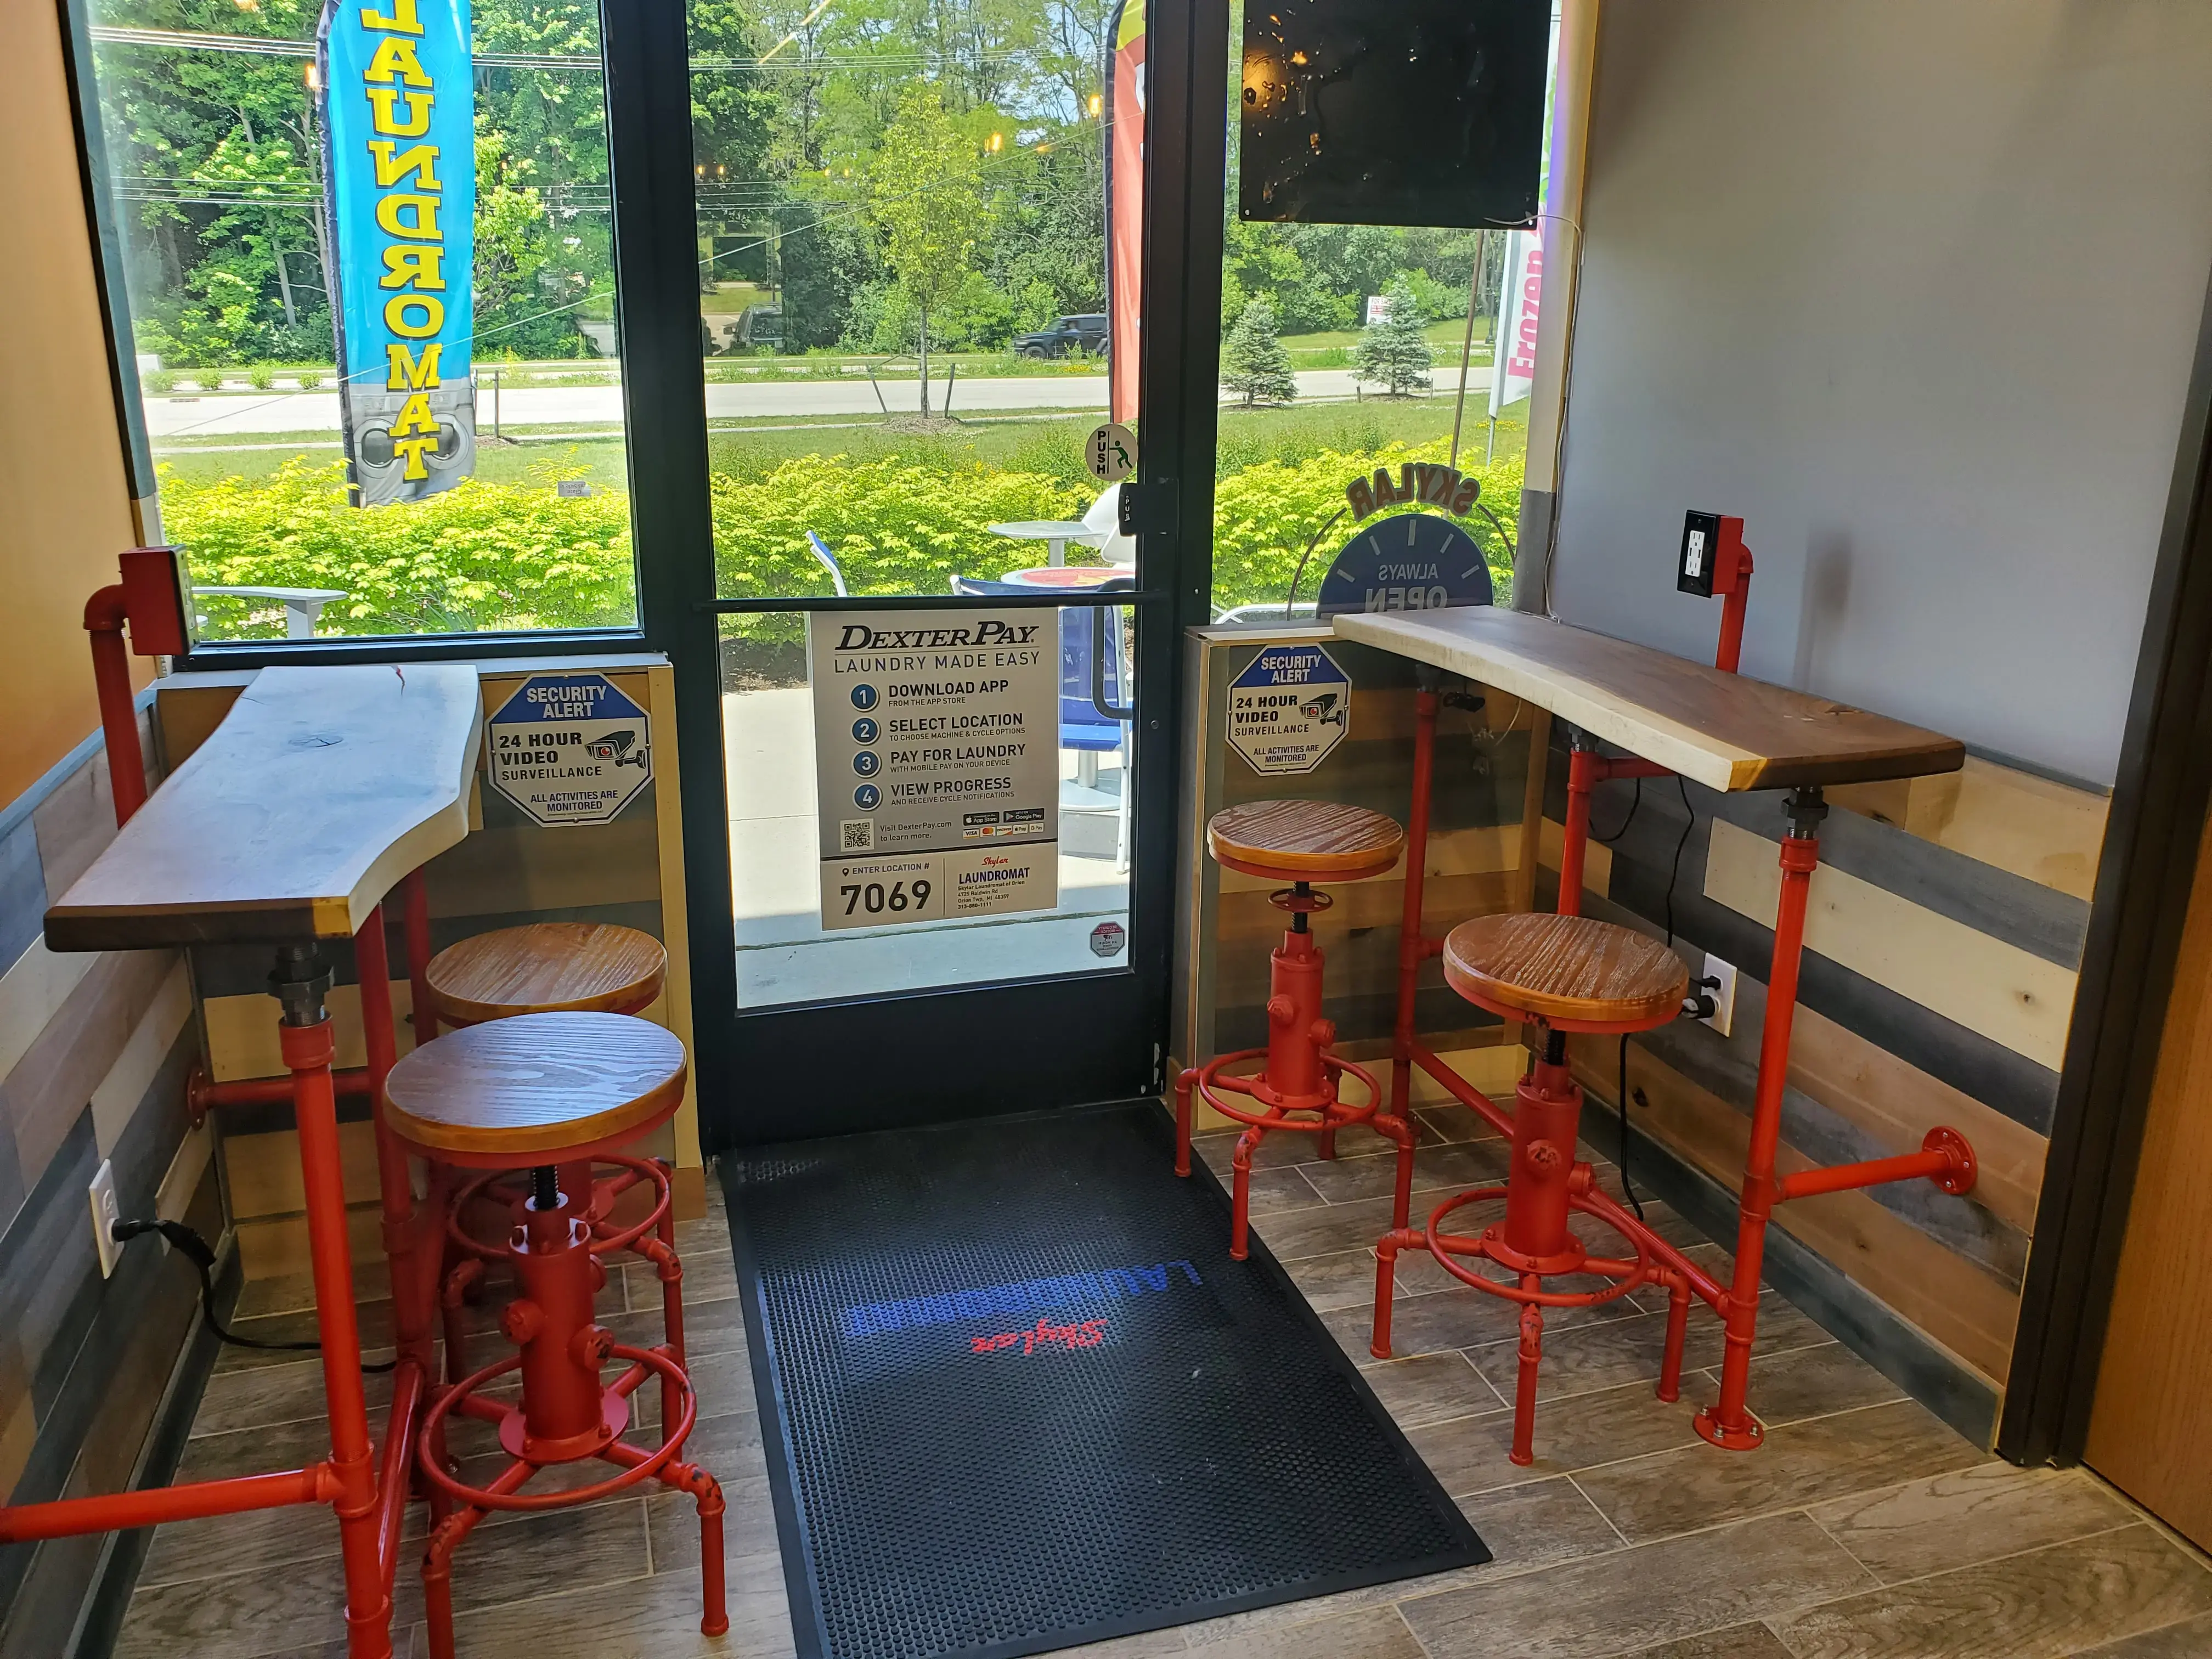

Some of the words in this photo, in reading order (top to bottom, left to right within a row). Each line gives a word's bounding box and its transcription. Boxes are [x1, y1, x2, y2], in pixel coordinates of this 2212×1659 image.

[1097, 431, 1107, 475] PUSH
[834, 656, 927, 673] LAUNDRY
[935, 653, 986, 669] MADE
[995, 651, 1040, 667] EASY
[1261, 655, 1322, 670] SECURITY
[1271, 669, 1310, 684] ALERT
[526, 685, 607, 703] SECURITY
[859, 690, 866, 704] 1
[889, 681, 975, 697] DOWNLOAD
[979, 680, 1009, 693] APP
[1236, 697, 1252, 708] 24
[1258, 695, 1297, 708] HOUR
[543, 702, 594, 719] ALERT
[1235, 710, 1279, 723] VIDEO
[860, 723, 870, 737] 2
[889, 717, 947, 732] SELECT
[951, 713, 1023, 729] LOCATION
[1234, 724, 1310, 736] SURVEILLANCE
[499, 735, 521, 748] 24
[528, 732, 583, 747] HOUR
[931, 731, 964, 739] MACHINE
[861, 756, 871, 770] 3
[890, 750, 919, 764] PAY
[923, 748, 952, 762] FOR
[957, 744, 1026, 760] LAUNDRY
[1267, 745, 1304, 754] ACTIVITIES
[500, 750, 559, 766] VIDEO
[1265, 753, 1307, 763] MONITORED
[501, 766, 602, 781] SURVEILLANCE
[910, 764, 938, 772] MOBILE
[531, 794, 548, 803] ALL
[550, 791, 599, 803] ACTIVITIES
[600, 790, 618, 799] ARE
[862, 789, 873, 804] 4
[890, 782, 929, 797] VIEW
[934, 777, 1011, 794] PROGRESS
[963, 791, 1015, 800] NOTIFICATIONS
[547, 801, 602, 812] MONITORED
[898, 822, 952, 831] DexterPay.com
[852, 866, 880, 874] ENTER
[882, 863, 922, 872] LOCATION
[981, 855, 1009, 868] Skylar
[959, 867, 1030, 884] LAUNDROMAT
[840, 879, 932, 915] 7069
[970, 1318, 1107, 1355] Skylar
